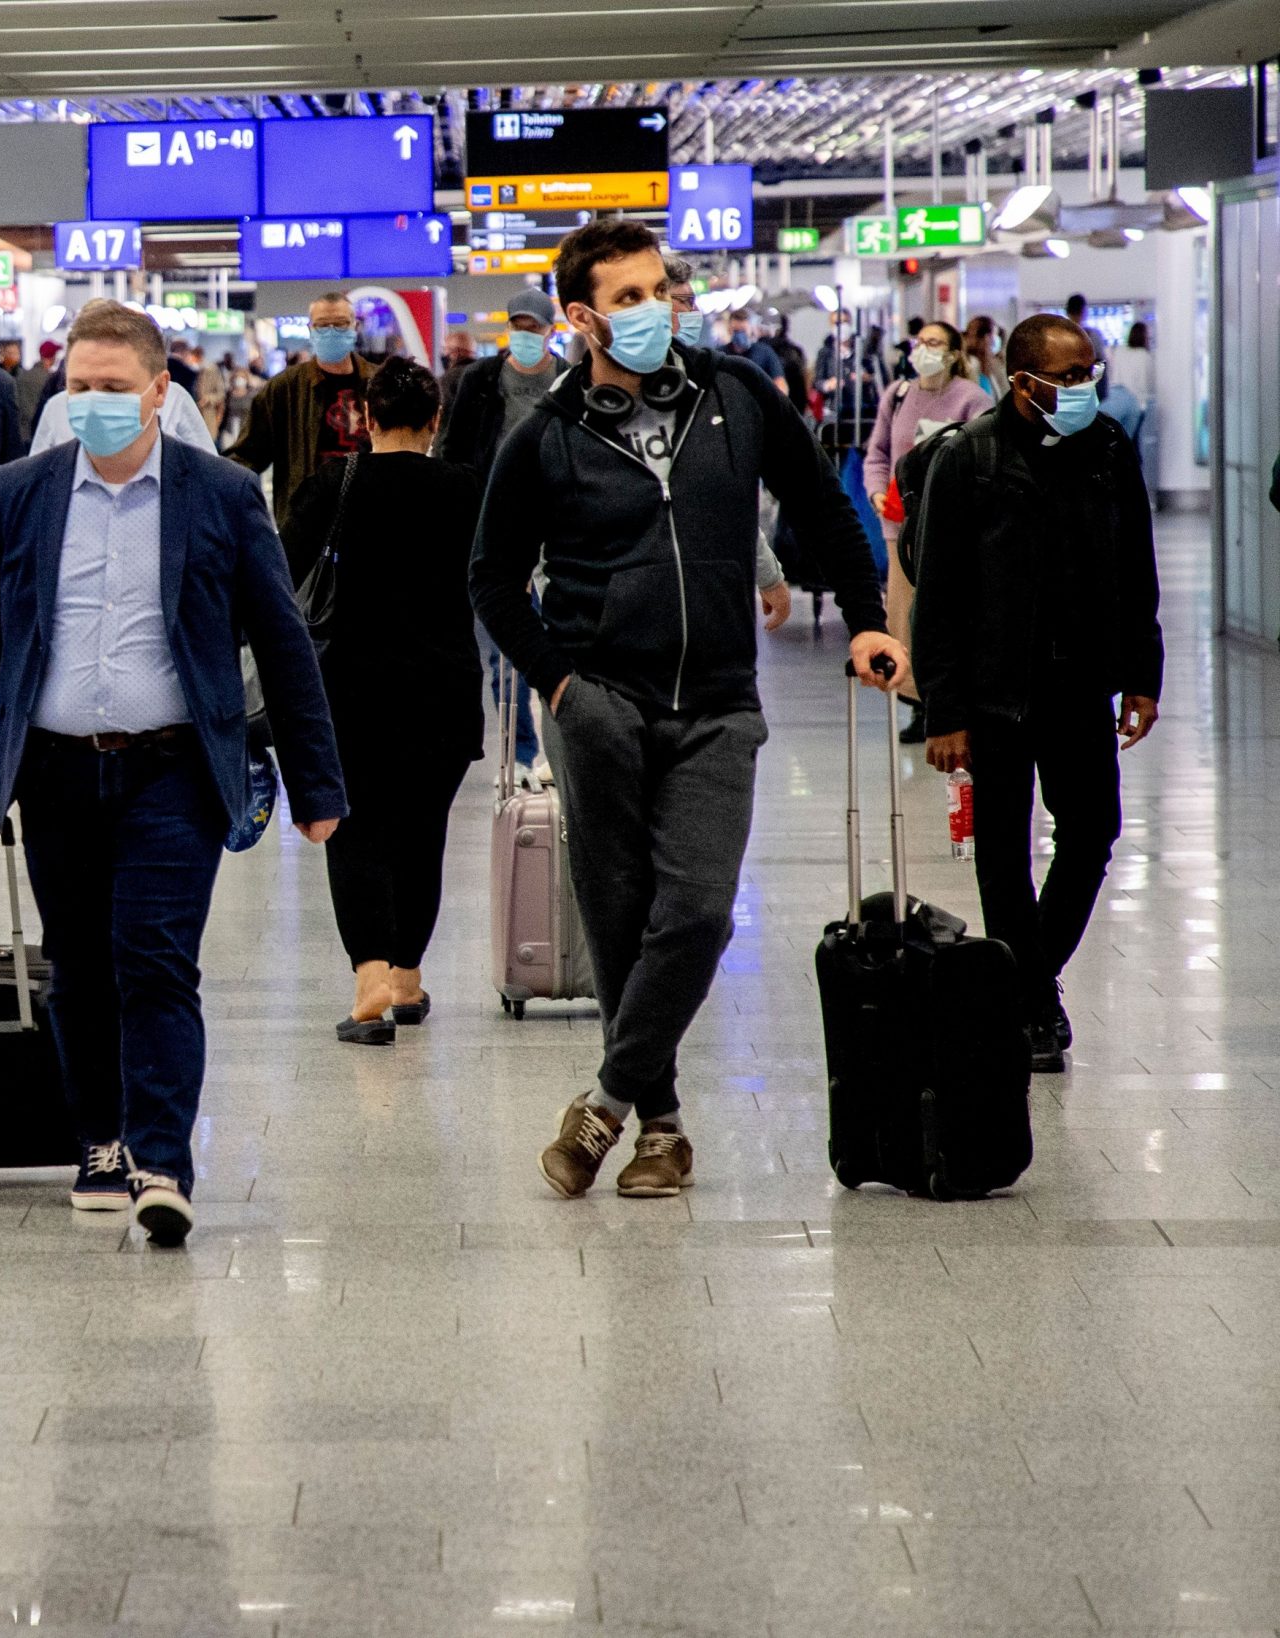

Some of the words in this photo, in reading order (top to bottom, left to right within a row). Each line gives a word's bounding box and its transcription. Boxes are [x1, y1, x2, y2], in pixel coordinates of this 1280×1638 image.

[521, 113, 564, 126] Toiletten
[522, 126, 555, 139] Toilets
[167, 131, 193, 165] A
[195, 129, 254, 150] 16-40
[588, 192, 630, 203] Lounges
[680, 207, 741, 241] A16
[66, 229, 125, 262] A17
